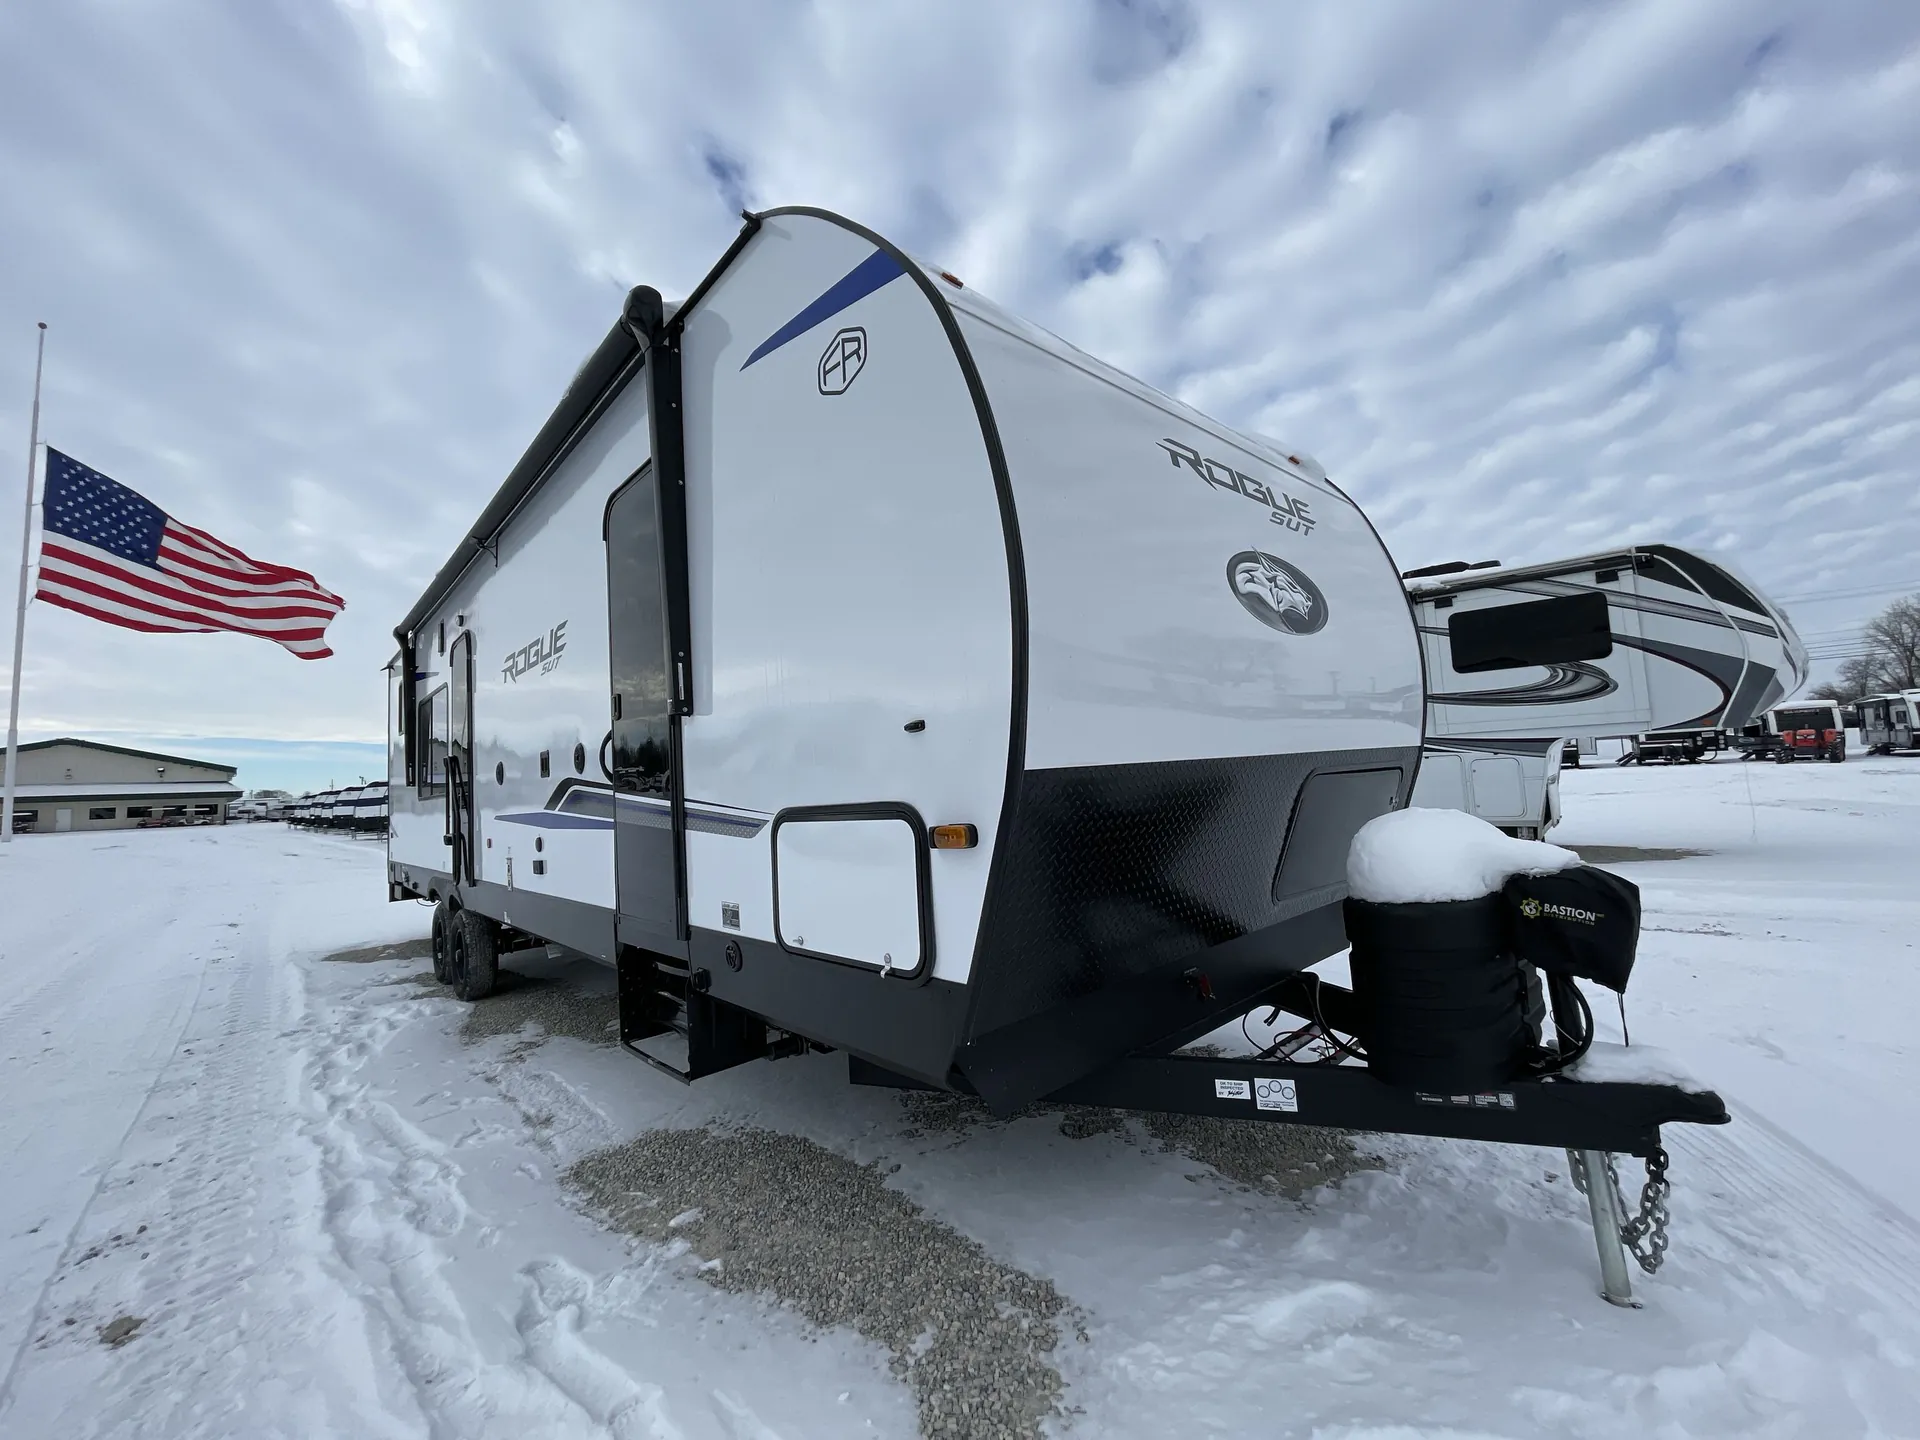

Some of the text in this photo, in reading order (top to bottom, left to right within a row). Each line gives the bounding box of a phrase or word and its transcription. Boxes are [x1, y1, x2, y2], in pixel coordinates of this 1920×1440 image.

[1155, 438, 1316, 525] ROGUE
[1269, 511, 1315, 536] SUT
[501, 619, 568, 684] ROGUE
[540, 654, 563, 676] SUT
[1544, 903, 1596, 921] BASTION
